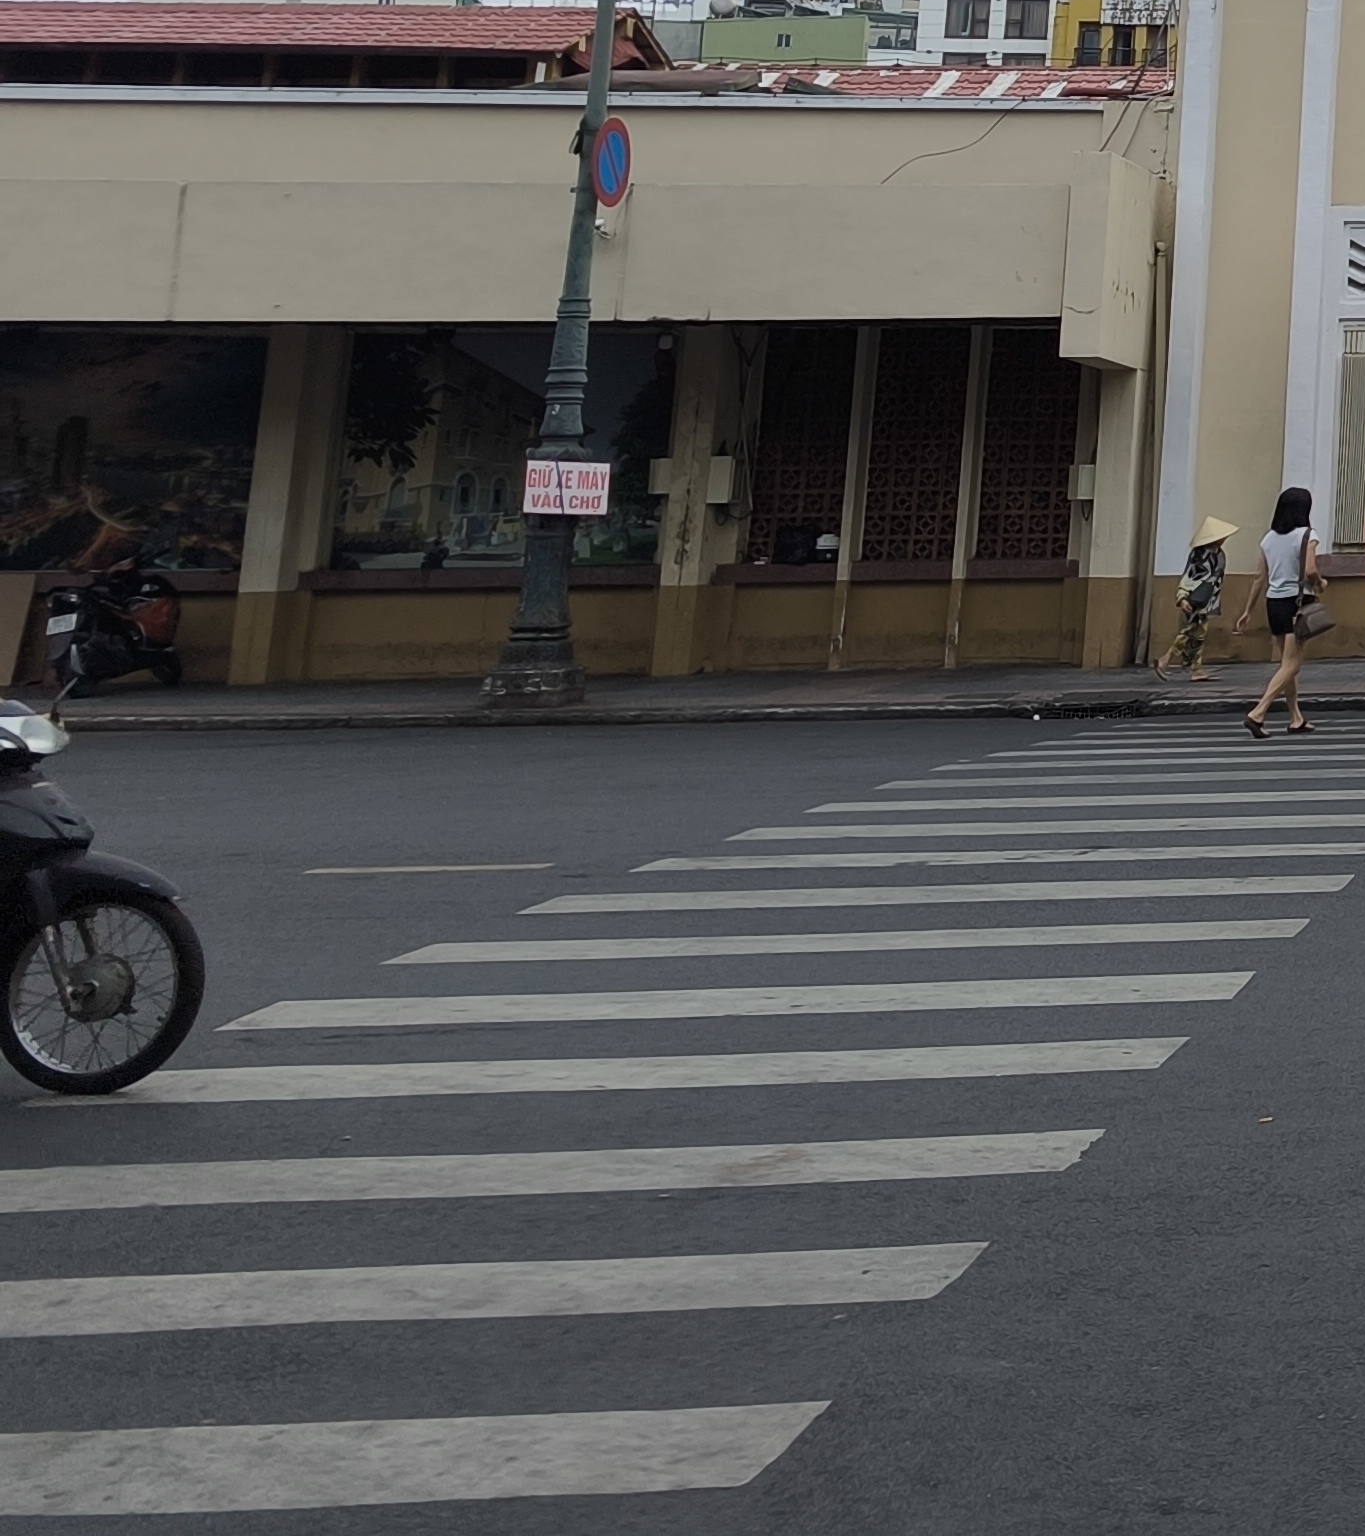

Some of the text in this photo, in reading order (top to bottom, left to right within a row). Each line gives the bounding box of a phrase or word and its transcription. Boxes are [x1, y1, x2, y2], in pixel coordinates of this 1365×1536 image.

[528, 465, 608, 491] GIỮ XE MÁY
[531, 491, 602, 513] VÀO CHỢ
